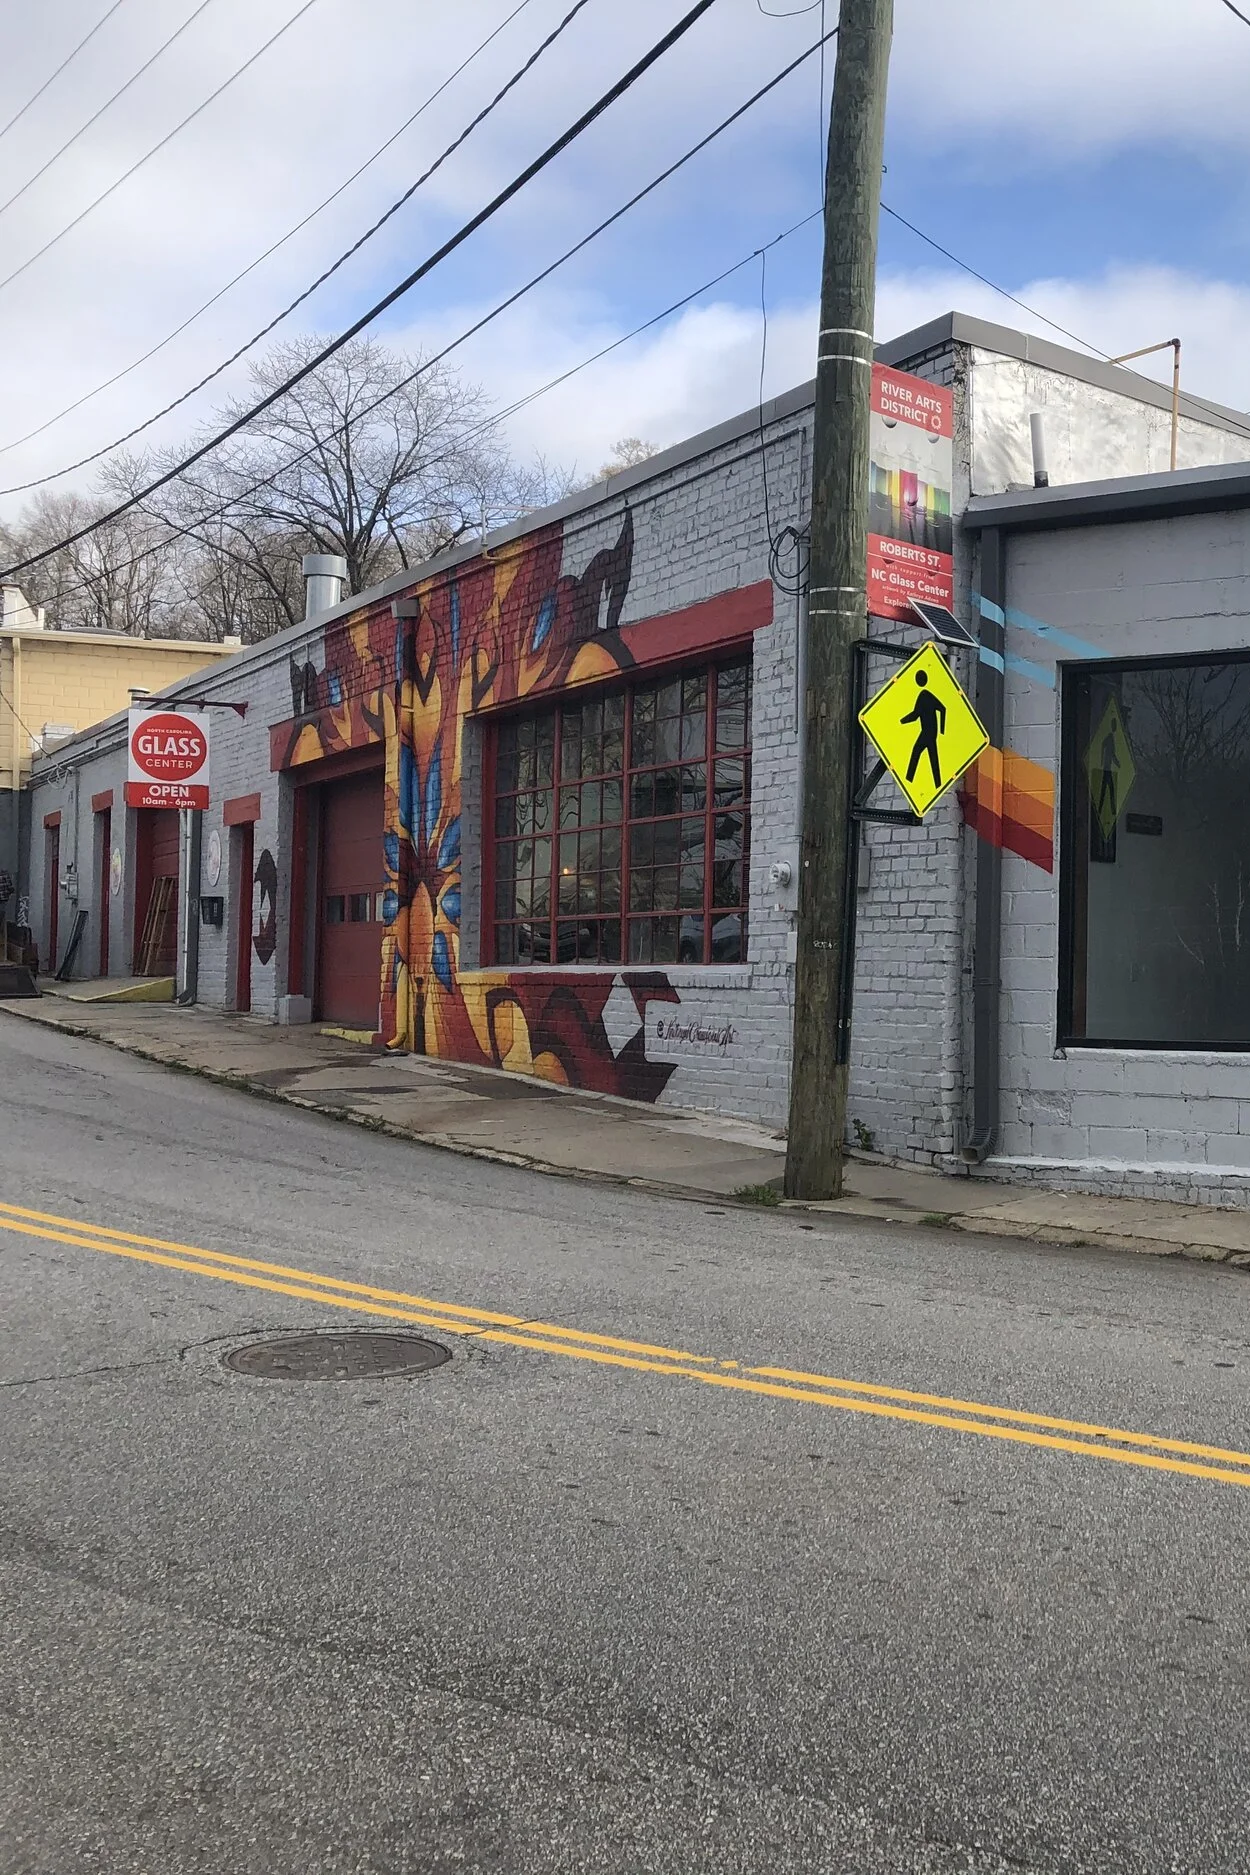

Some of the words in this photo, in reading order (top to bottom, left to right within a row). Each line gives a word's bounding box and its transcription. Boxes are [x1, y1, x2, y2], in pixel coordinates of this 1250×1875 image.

[881, 381, 912, 403] RIVER
[915, 394, 942, 414] ARTS
[880, 397, 928, 424] DISTRICT
[880, 541, 926, 563] ROBERTS
[927, 554, 941, 567] ST.
[871, 568, 887, 582] NC
[889, 573, 915, 589] Glass
[917, 580, 949, 598] Center
[900, 568, 922, 577] support
[138, 735, 201, 757] GLASS
[145, 758, 192, 768] CENTER
[142, 797, 167, 806] 10am
[175, 798, 196, 808] 6pm
[149, 785, 190, 798] OPEN
